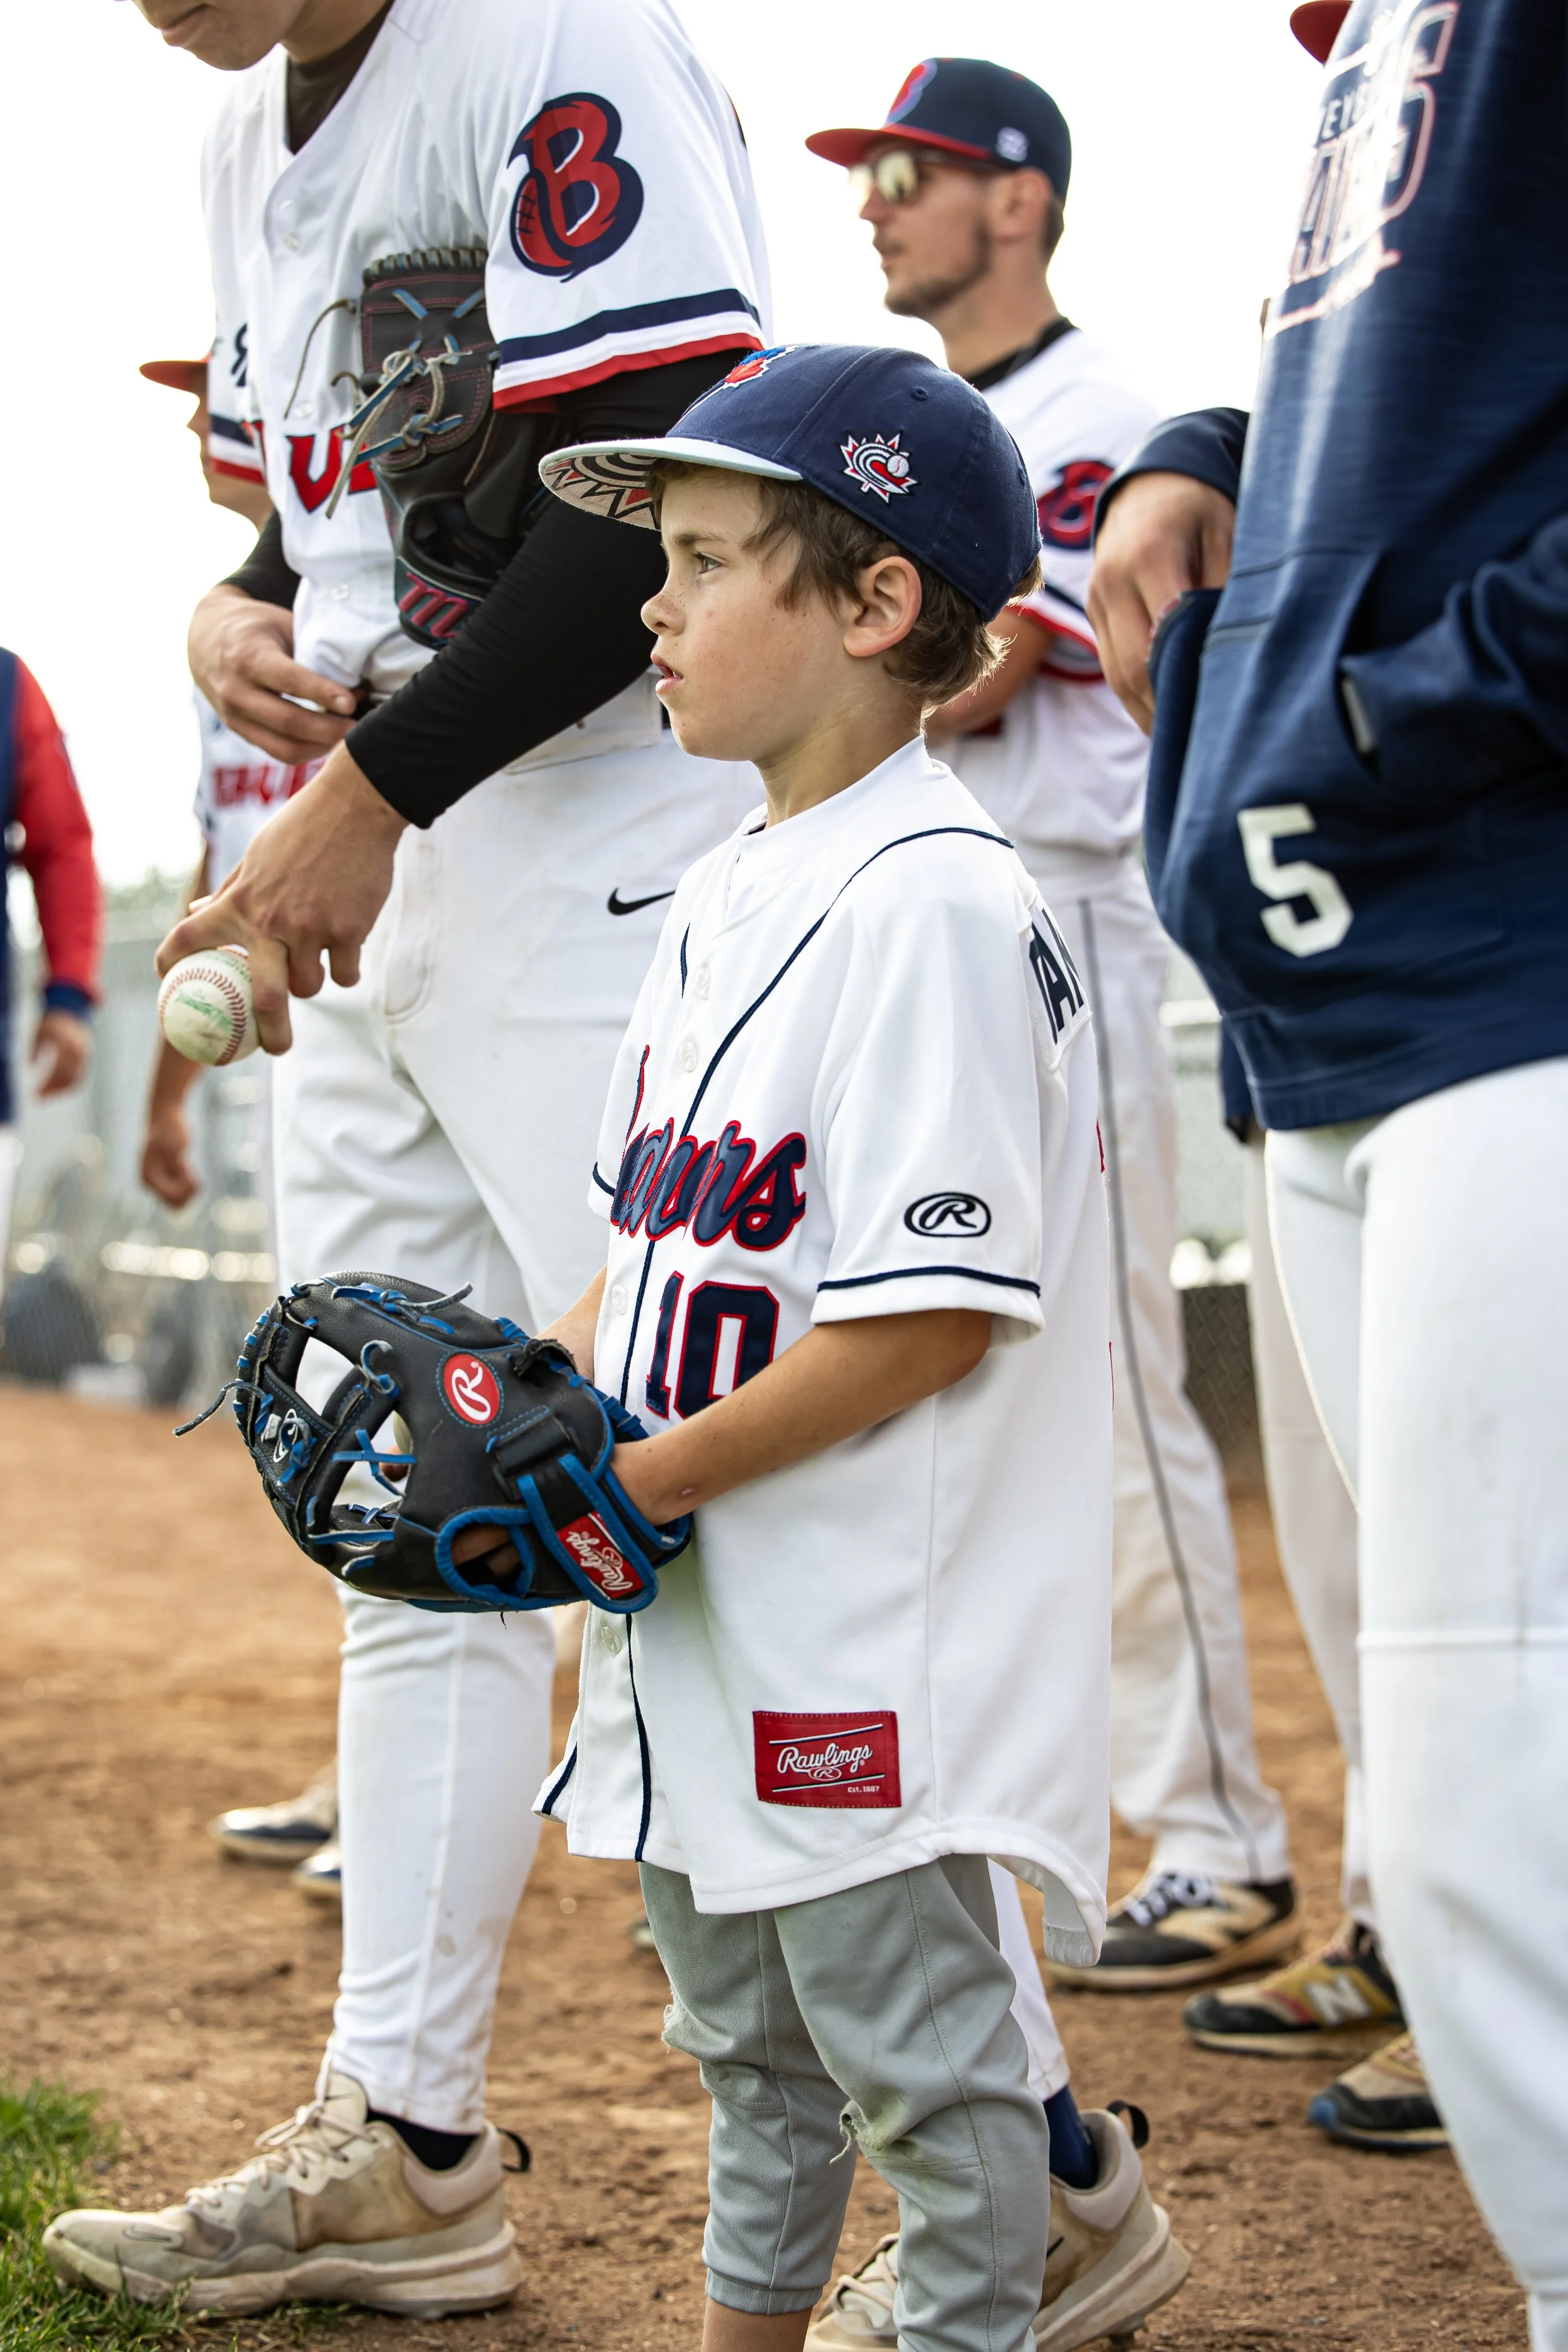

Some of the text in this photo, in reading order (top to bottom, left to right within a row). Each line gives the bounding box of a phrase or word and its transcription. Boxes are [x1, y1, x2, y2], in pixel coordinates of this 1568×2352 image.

[507, 92, 644, 283] B
[1237, 802, 1355, 958] 5
[919, 1198, 977, 1230] R
[646, 1270, 780, 1421] 10
[451, 1366, 491, 1421] R
[566, 1531, 633, 1591] Rawlings
[777, 1742, 873, 1774] Rawlings
[1305, 1973, 1372, 2026] N
